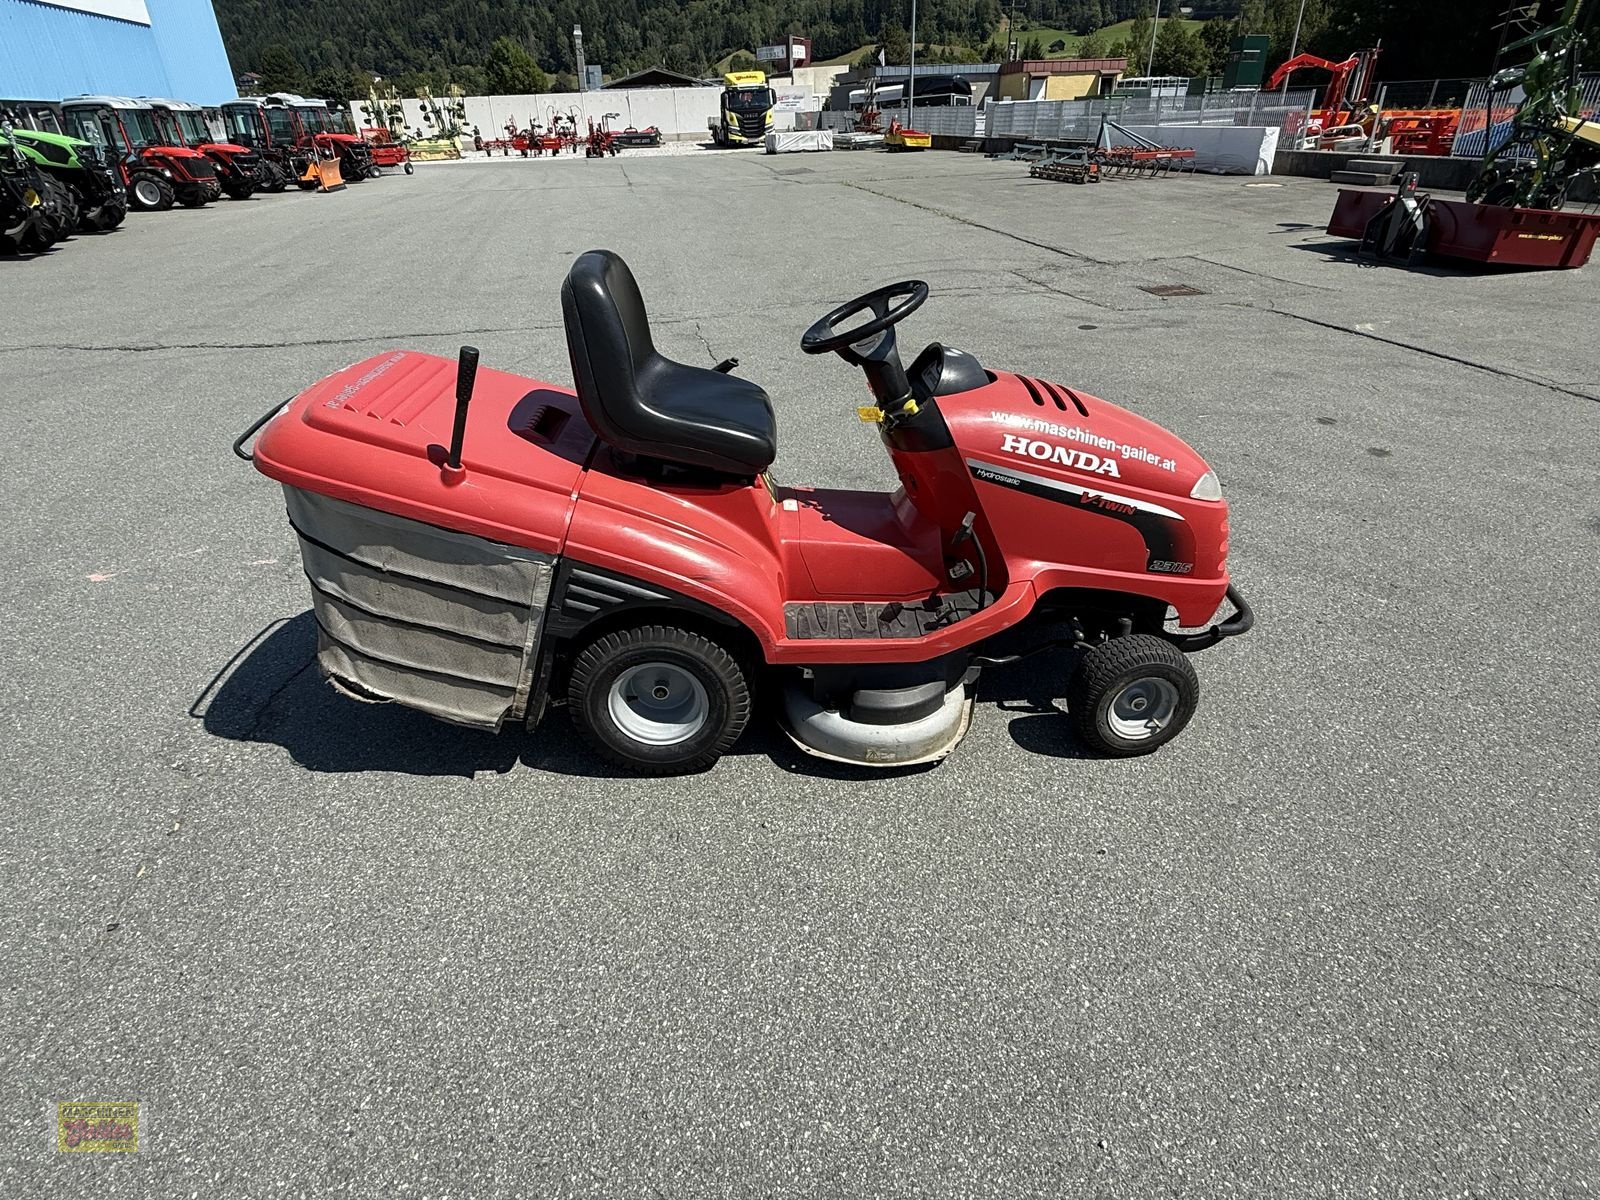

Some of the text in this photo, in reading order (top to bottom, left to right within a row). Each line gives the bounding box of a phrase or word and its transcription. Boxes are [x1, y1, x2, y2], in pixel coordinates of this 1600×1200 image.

[991, 410, 1177, 473] www.maschinen-gailer.at
[1001, 433, 1121, 478] HONDA
[976, 468, 1021, 486] Hydrostatic
[1079, 491, 1138, 515] V-TWIN
[1149, 560, 1194, 574] 2315
